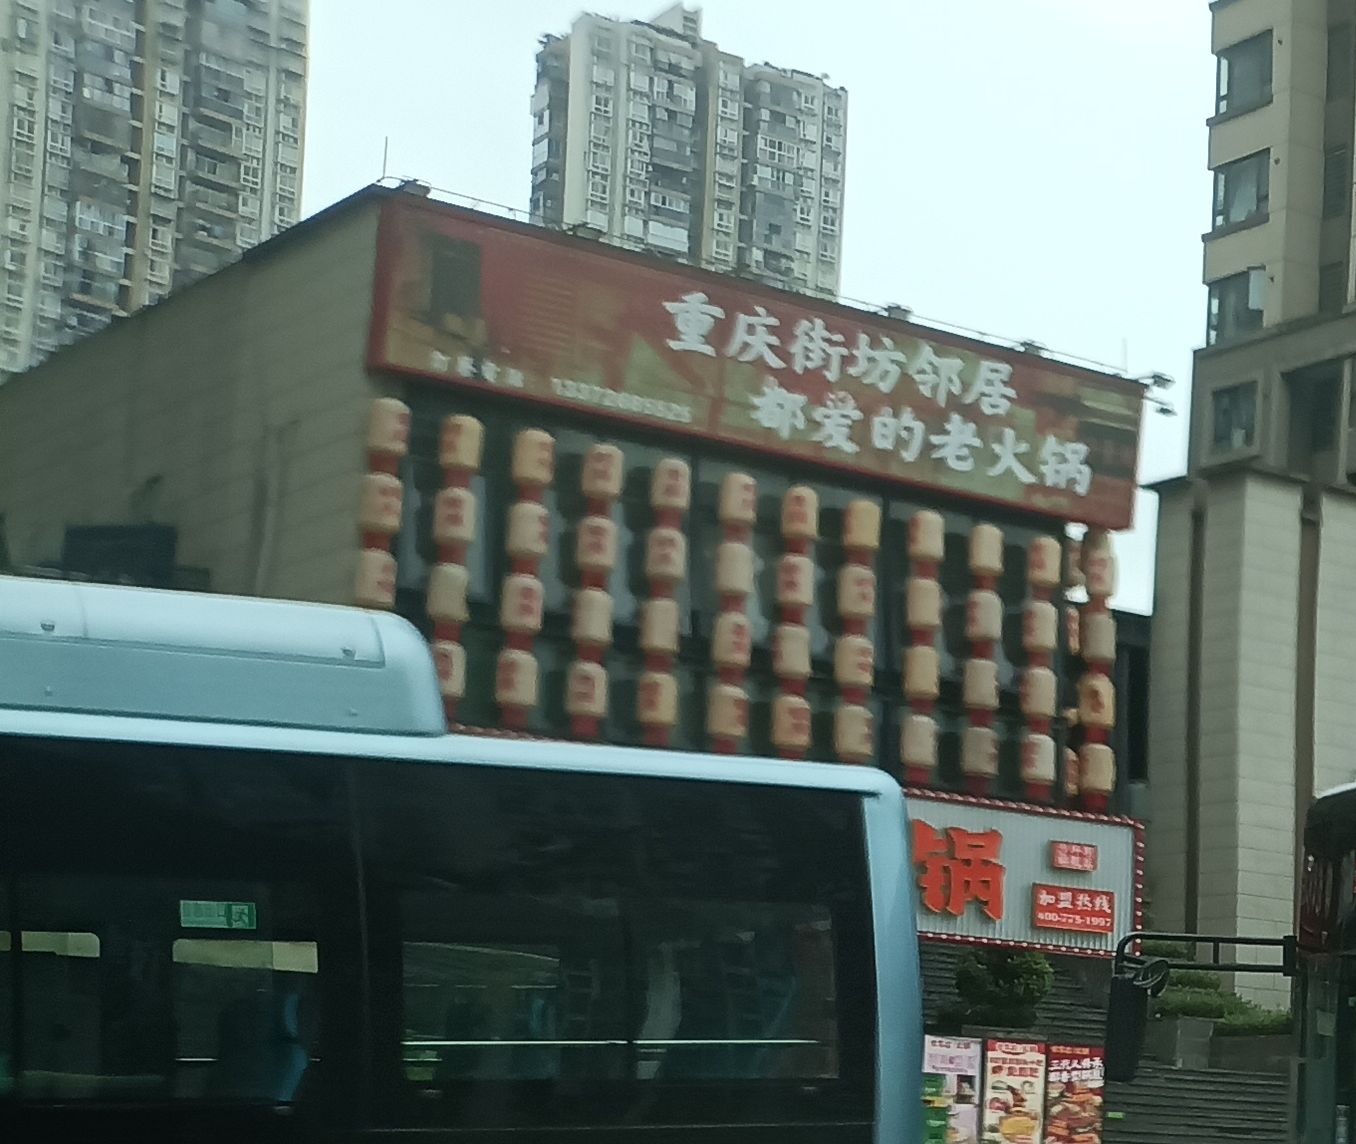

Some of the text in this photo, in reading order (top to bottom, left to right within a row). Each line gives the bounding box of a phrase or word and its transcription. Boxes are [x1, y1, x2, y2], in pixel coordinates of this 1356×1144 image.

[662, 292, 1017, 416] 重庆街坊邻居
[749, 377, 1092, 496] 都爱的老火锅
[912, 819, 1006, 921] 锅
[1038, 889, 1112, 914] 加盟热线
